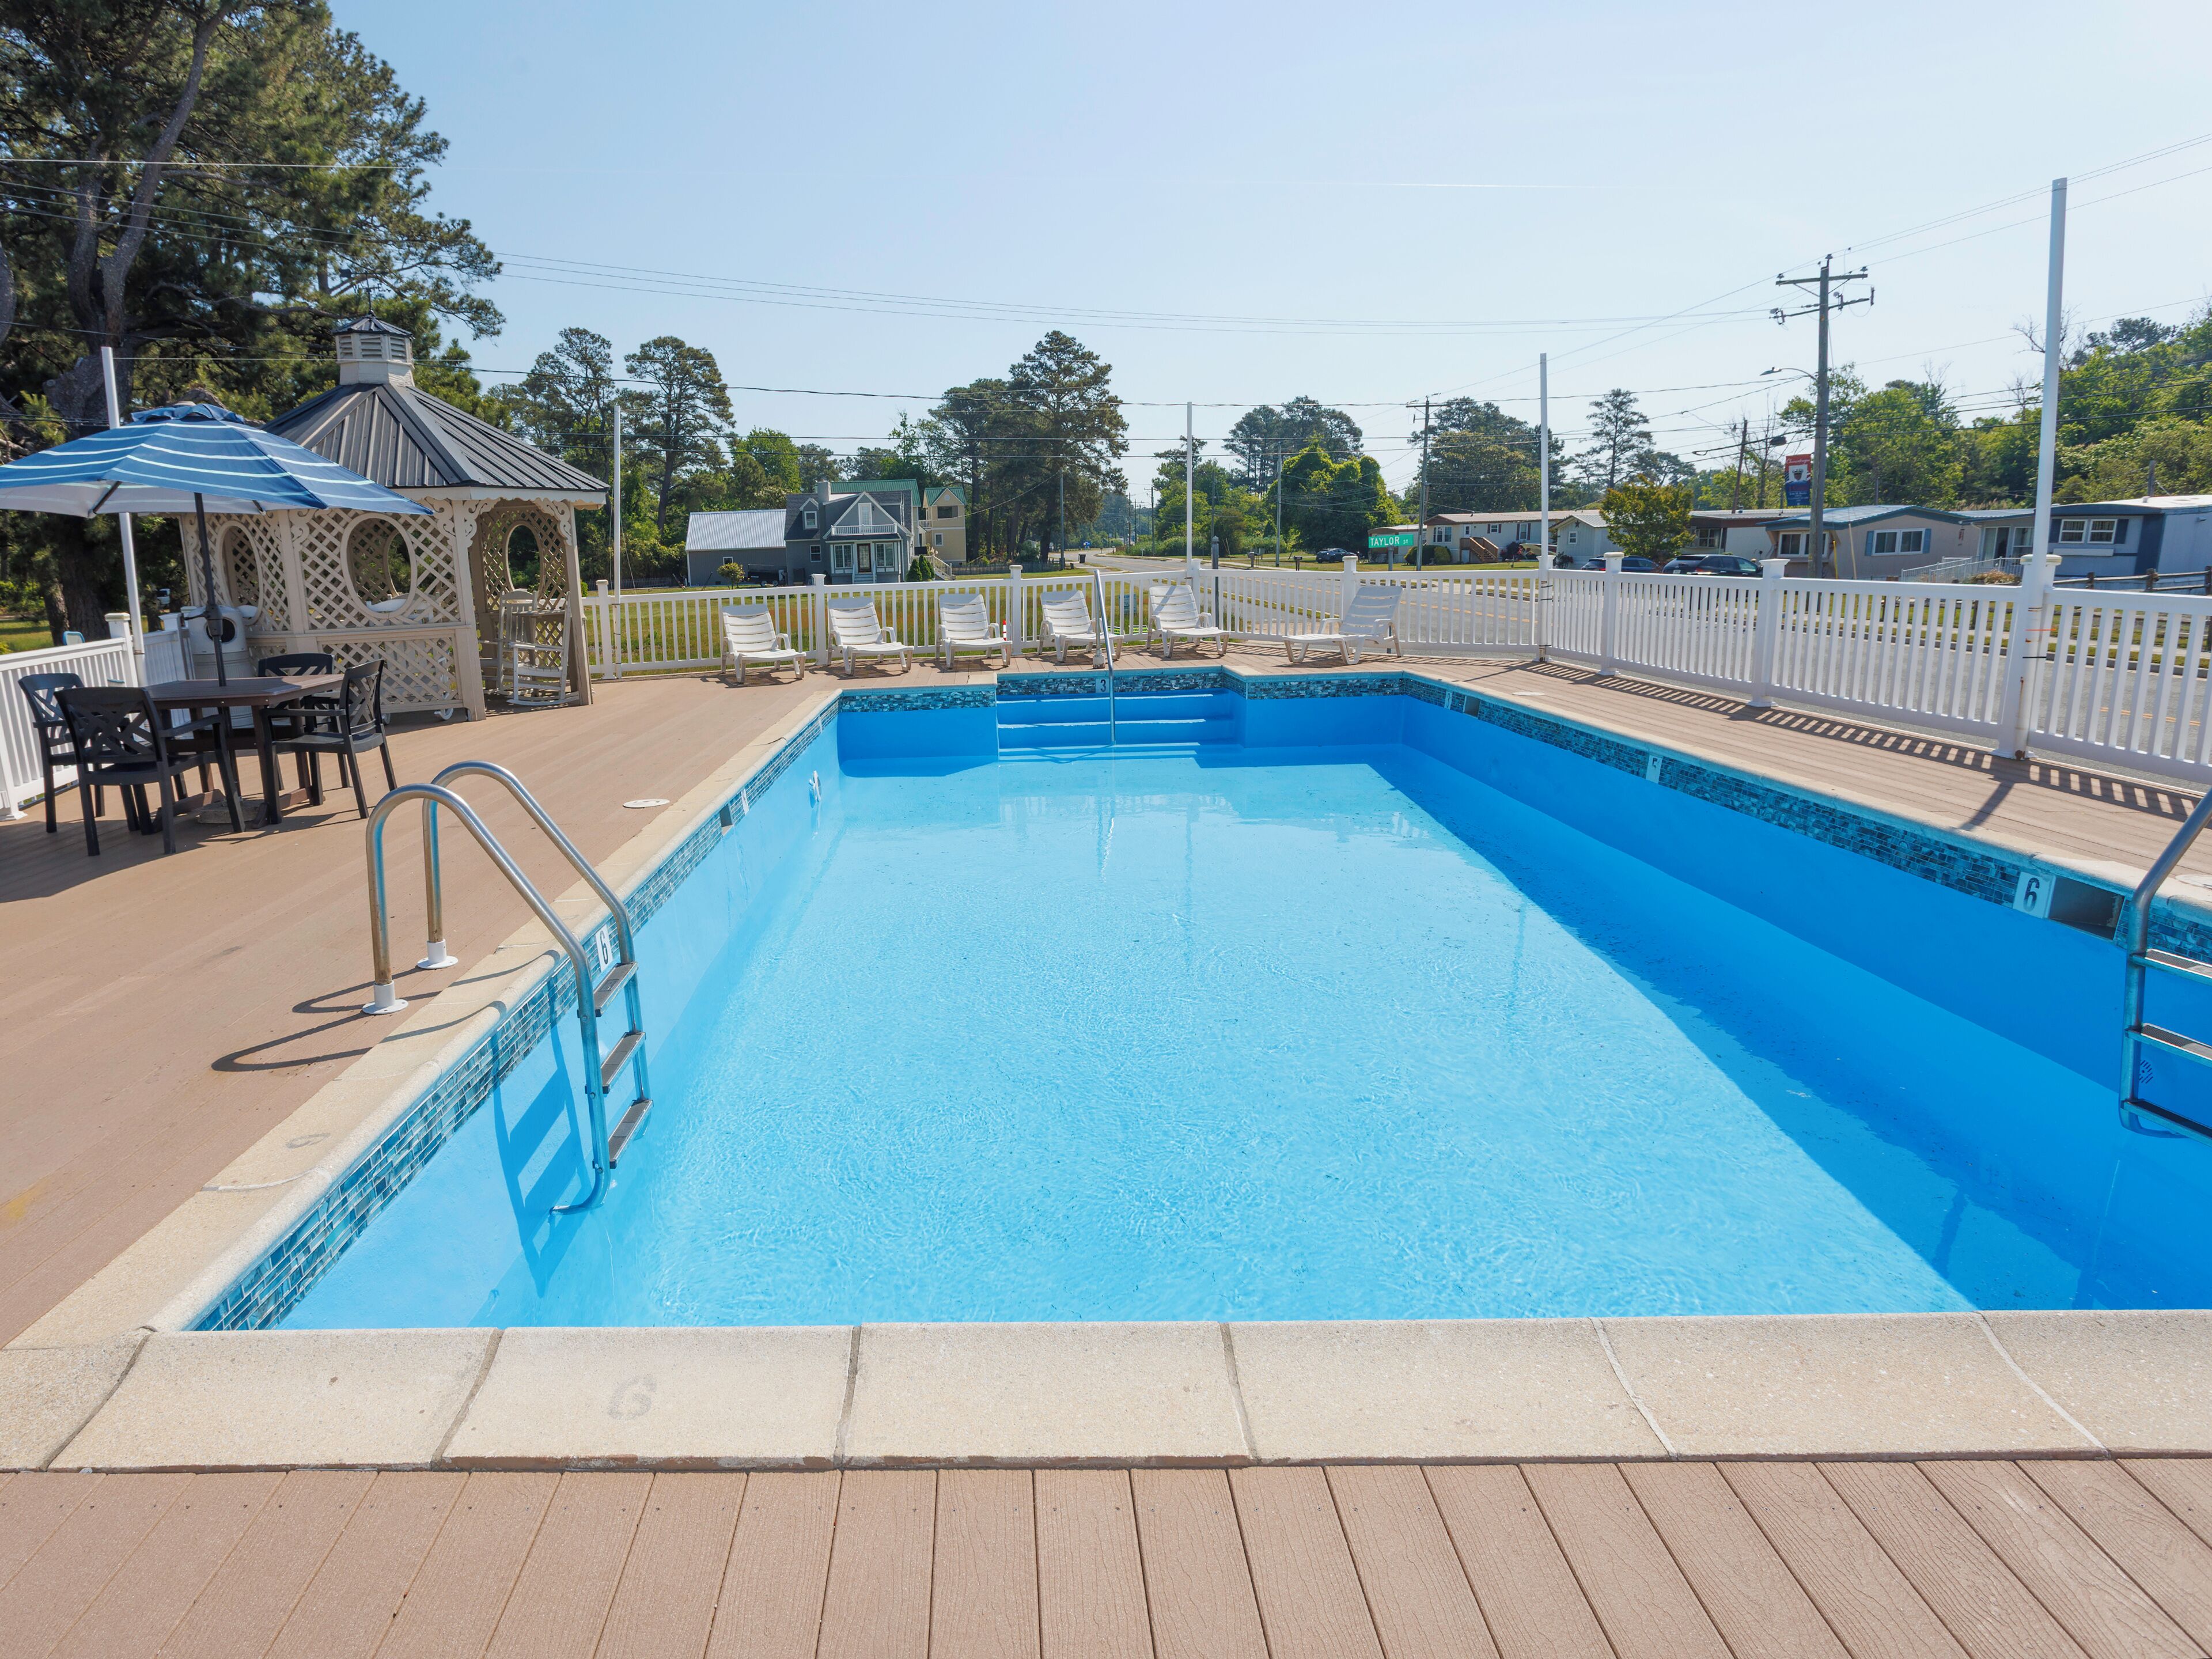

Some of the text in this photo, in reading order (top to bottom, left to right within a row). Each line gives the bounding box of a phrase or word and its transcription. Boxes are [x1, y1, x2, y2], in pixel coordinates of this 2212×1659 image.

[1370, 536, 1400, 546] TAYLOR
[1100, 679, 1106, 692] 3
[2023, 877, 2040, 912] 6
[600, 930, 608, 965] 6
